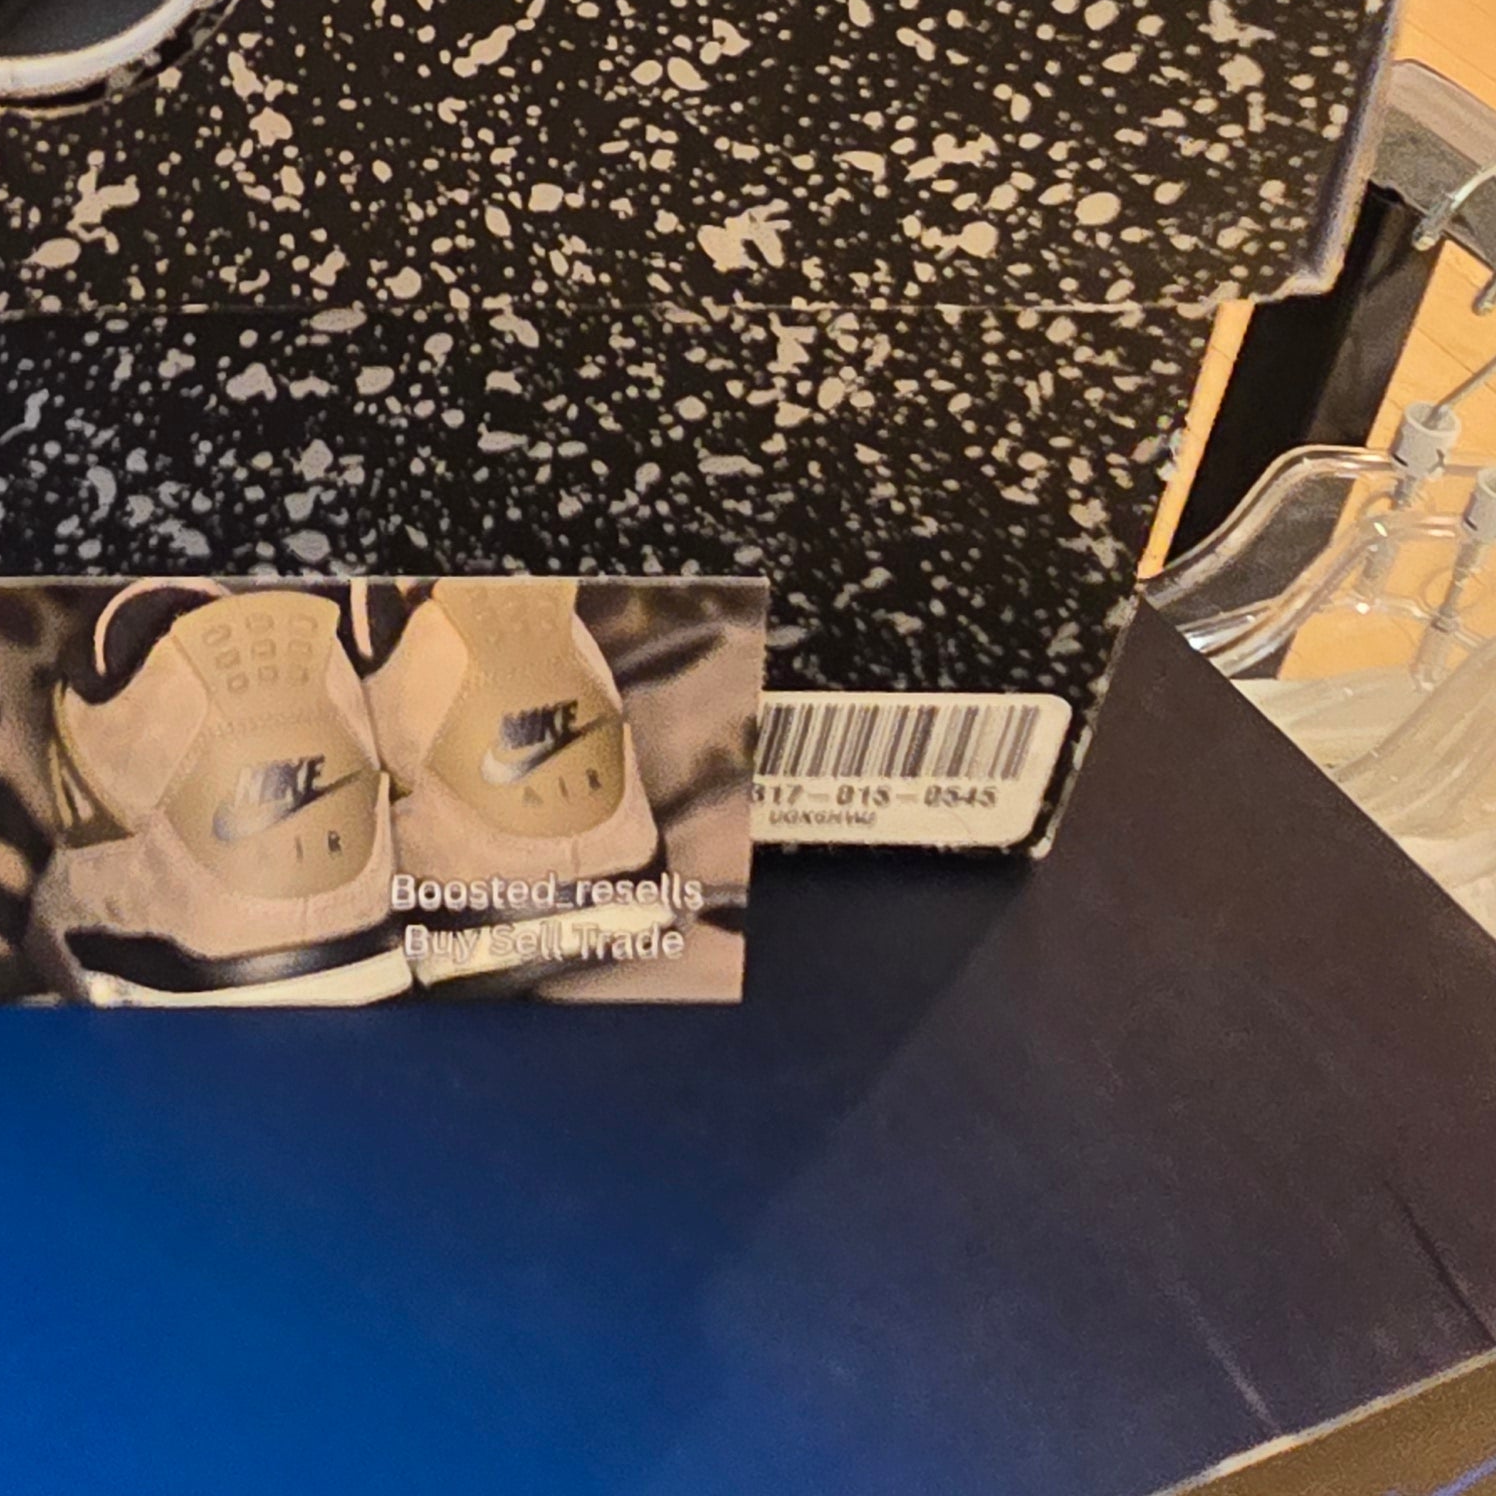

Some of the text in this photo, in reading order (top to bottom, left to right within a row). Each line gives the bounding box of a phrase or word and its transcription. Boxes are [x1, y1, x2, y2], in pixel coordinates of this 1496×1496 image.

[500, 699, 579, 750] NIKE
[404, 920, 685, 964] Buy Sell Trade
